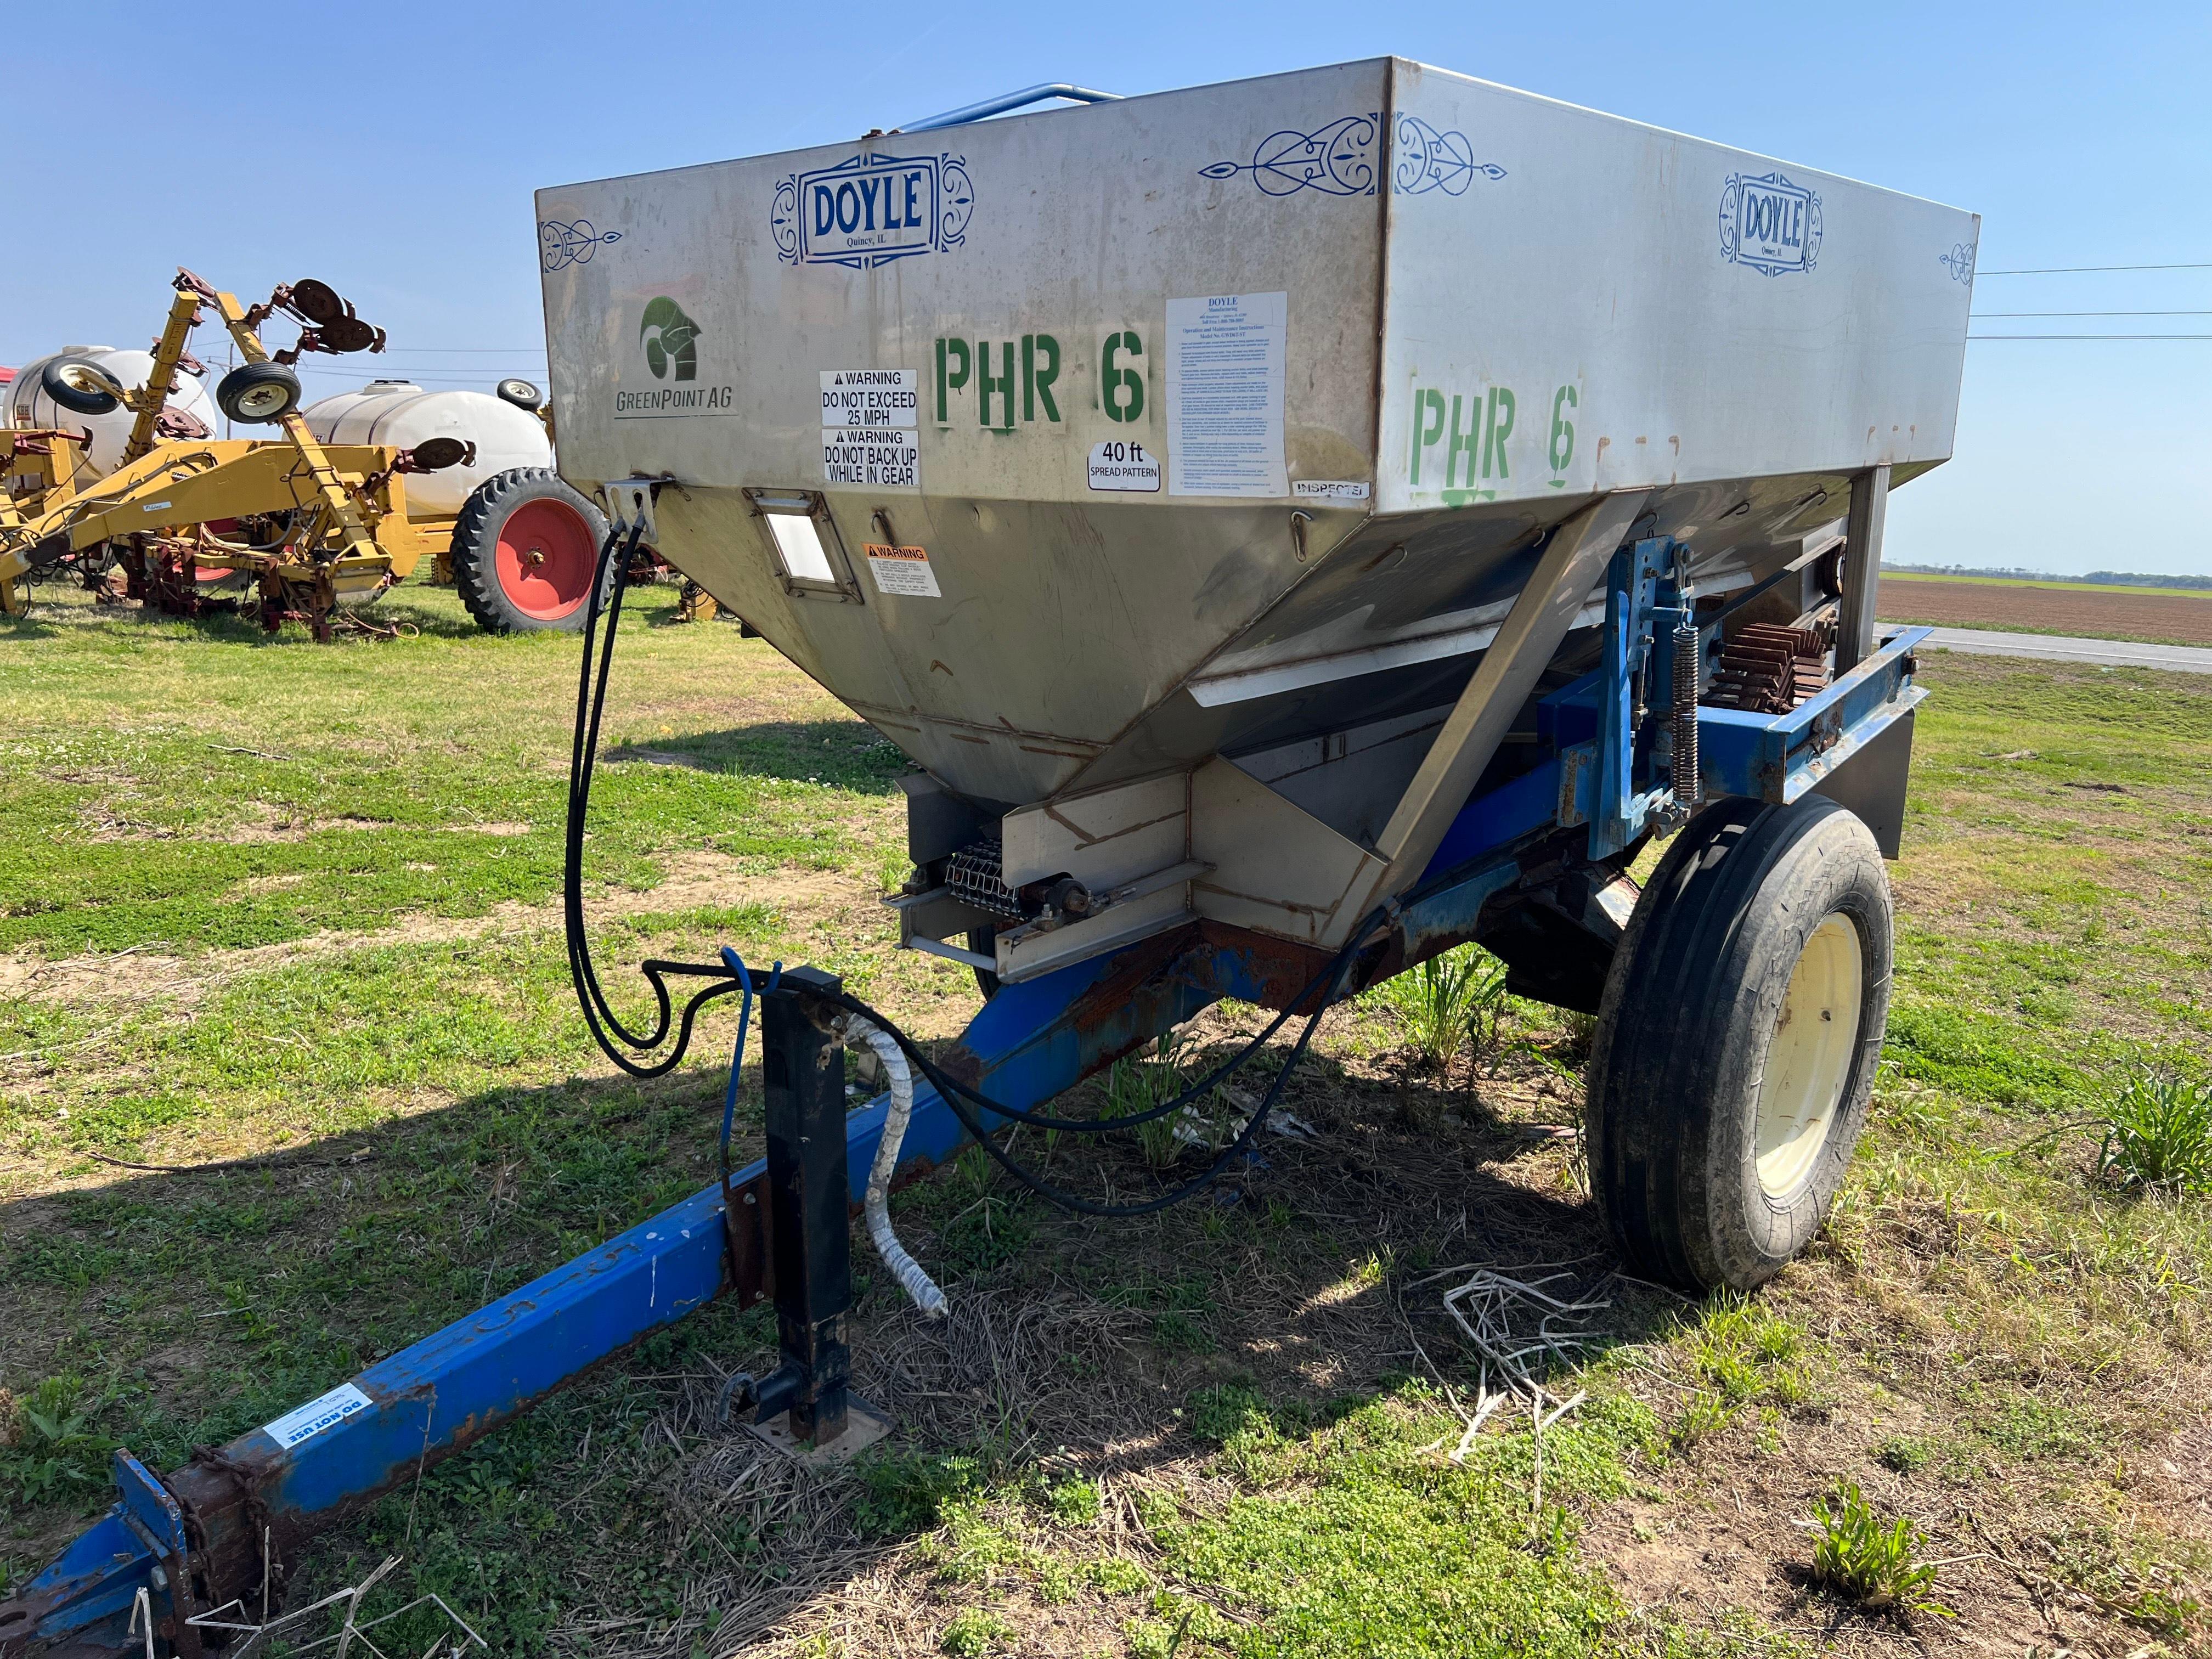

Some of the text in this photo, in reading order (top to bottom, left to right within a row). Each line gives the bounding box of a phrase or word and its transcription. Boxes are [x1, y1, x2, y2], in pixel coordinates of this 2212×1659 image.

[813, 171, 922, 236] DOYLE
[1745, 190, 1803, 248] DOYLE
[847, 234, 886, 247] Quincy, IL
[1209, 297, 1238, 307] DOYLE
[846, 372, 901, 385] WARNING
[936, 331, 1144, 426] PHR 6
[707, 386, 732, 409] AG
[823, 392, 916, 408] DO NOT EXCEED
[848, 409, 890, 425] 25 MPH
[847, 431, 903, 444] WARNING
[1410, 385, 1577, 488] PHR 6
[825, 446, 917, 466] DO NOT BACK UP
[1103, 441, 1143, 462] 40 ft
[829, 465, 913, 485] WHILE IN GEAR
[1091, 467, 1157, 477] SPREAD PATTERN
[877, 546, 924, 559] WARNING
[288, 1401, 362, 1442] DO NOT USE
